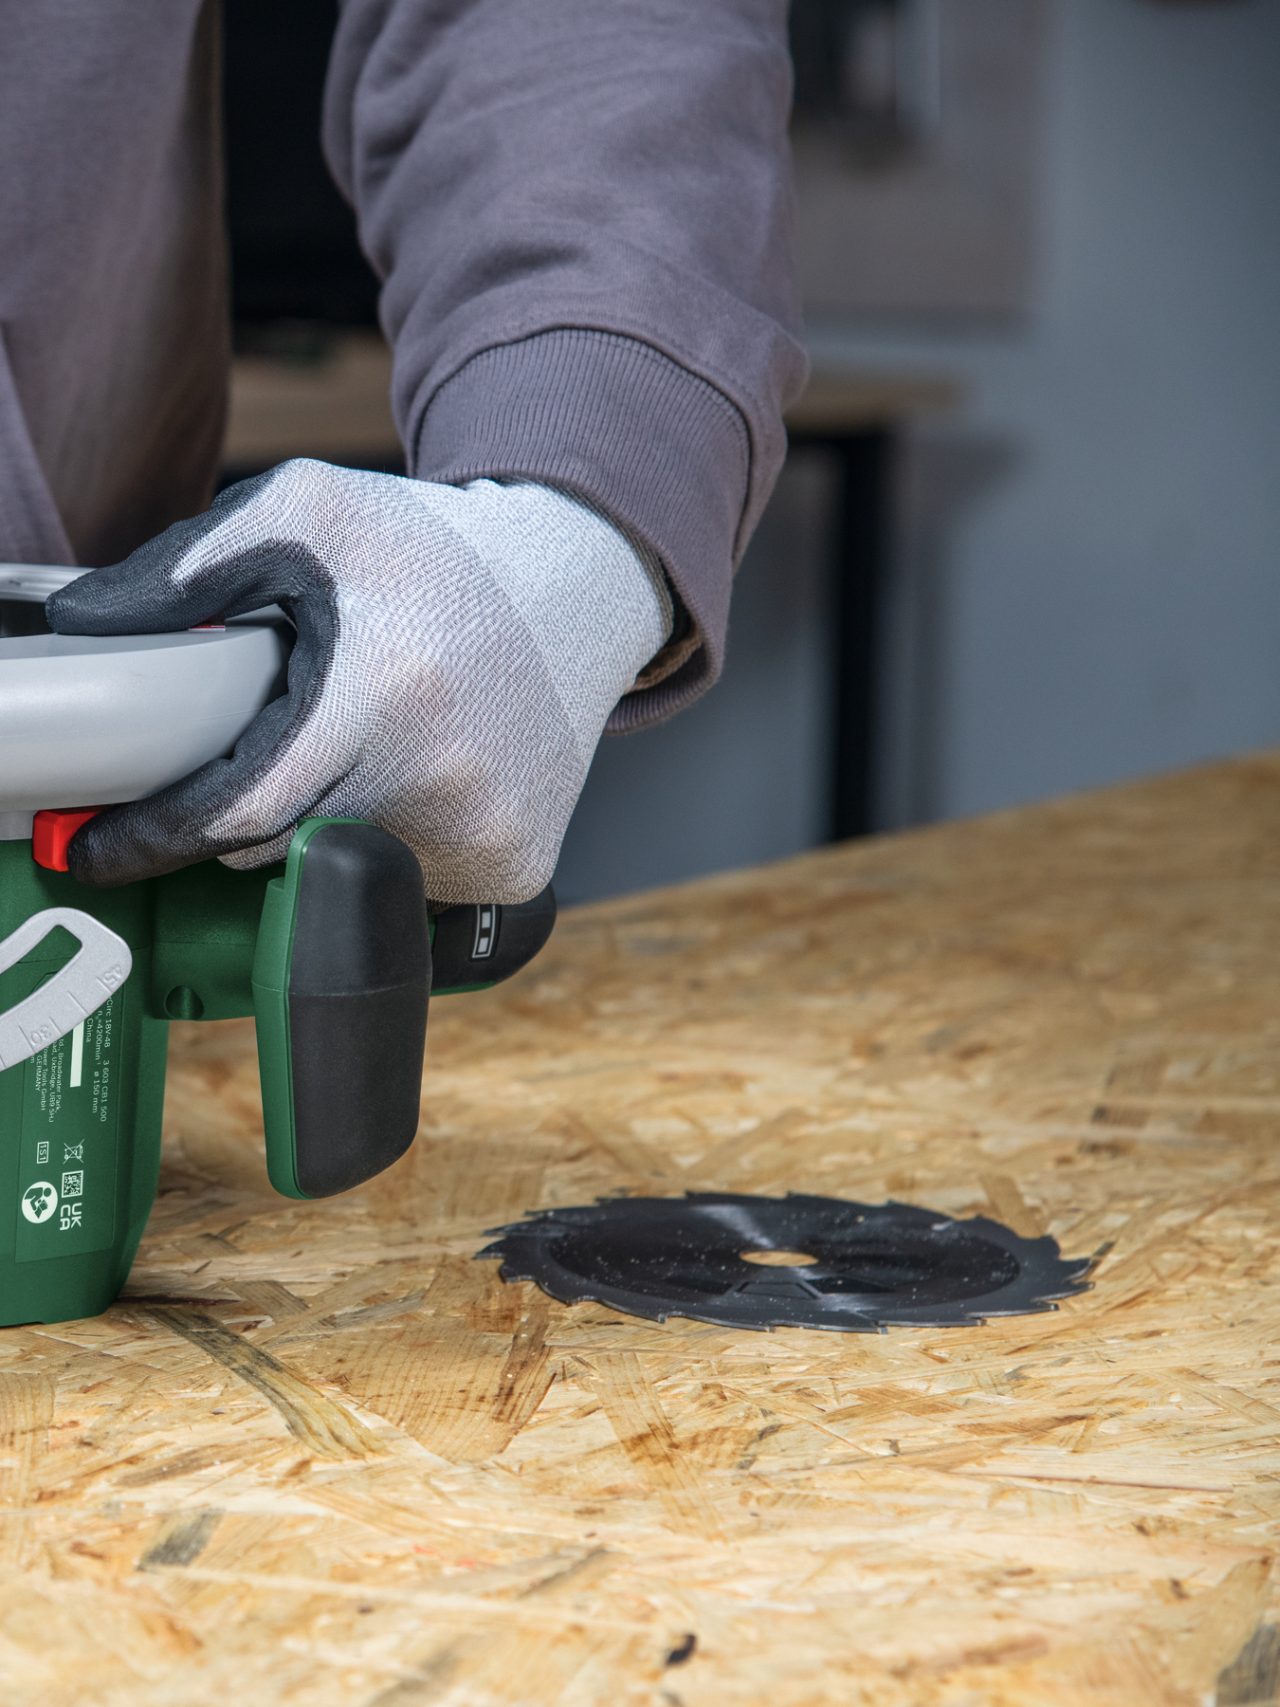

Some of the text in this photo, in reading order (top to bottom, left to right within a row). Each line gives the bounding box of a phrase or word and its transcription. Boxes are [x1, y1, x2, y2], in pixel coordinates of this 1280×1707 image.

[31, 1025, 51, 1047] 30
[86, 1018, 94, 1043] China
[104, 1019, 112, 1049] 18V-48
[56, 1052, 64, 1093] Broadwater
[92, 1097, 98, 1114] mm
[60, 1205, 71, 1230] CA
[71, 1203, 82, 1228] UK
